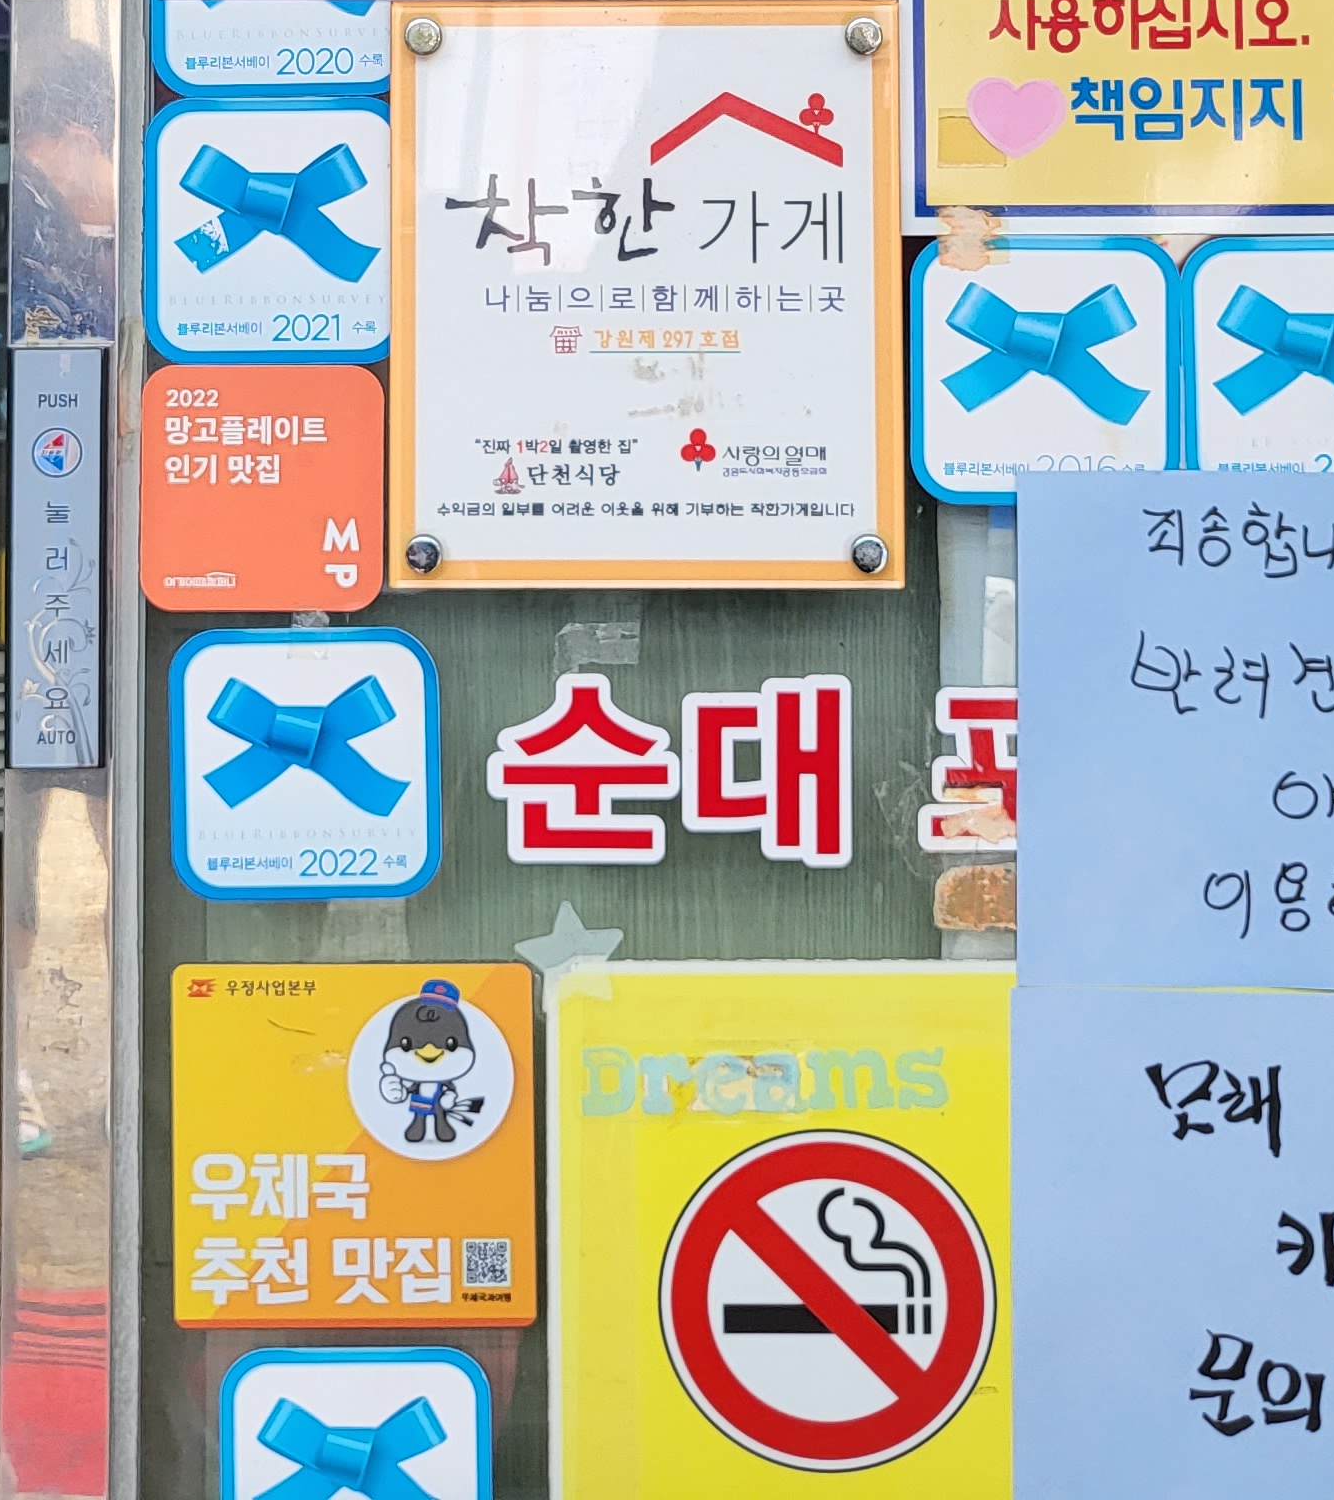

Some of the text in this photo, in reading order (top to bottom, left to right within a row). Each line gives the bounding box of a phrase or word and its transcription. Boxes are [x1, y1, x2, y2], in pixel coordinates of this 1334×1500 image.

[184, 47, 385, 76] 블루리본서베이 2020 수록
[1070, 76, 1304, 142] 책임지지
[445, 173, 845, 267] 착한 가게
[176, 312, 378, 342] 블루리본서베이 2021 수록
[594, 329, 741, 349] 강원제 297 호점
[37, 393, 78, 408] PUSH
[165, 387, 220, 408] 2022
[164, 415, 328, 446] 망고플레이트
[516, 438, 563, 455] 1박2일
[164, 455, 282, 485] 인기 맛집
[527, 463, 620, 487] 단천식당
[1036, 454, 1117, 472] 2016
[437, 502, 496, 517] 수익금의
[551, 502, 595, 517] 어려운
[651, 502, 680, 517] 위해
[685, 502, 745, 517] 기부하는
[323, 517, 360, 588] MP
[36, 729, 77, 746] AUTO
[490, 675, 850, 866] 순대
[206, 847, 408, 877] 블루리본서베이 2022 수록
[224, 978, 318, 998] 우정사업본부
[581, 1046, 951, 1116] Dreams
[1145, 1059, 1281, 1157] 모래
[190, 1153, 370, 1220] 우체국
[190, 1237, 453, 1306] 추천 맛집
[1189, 1330, 1325, 1436] 문의
